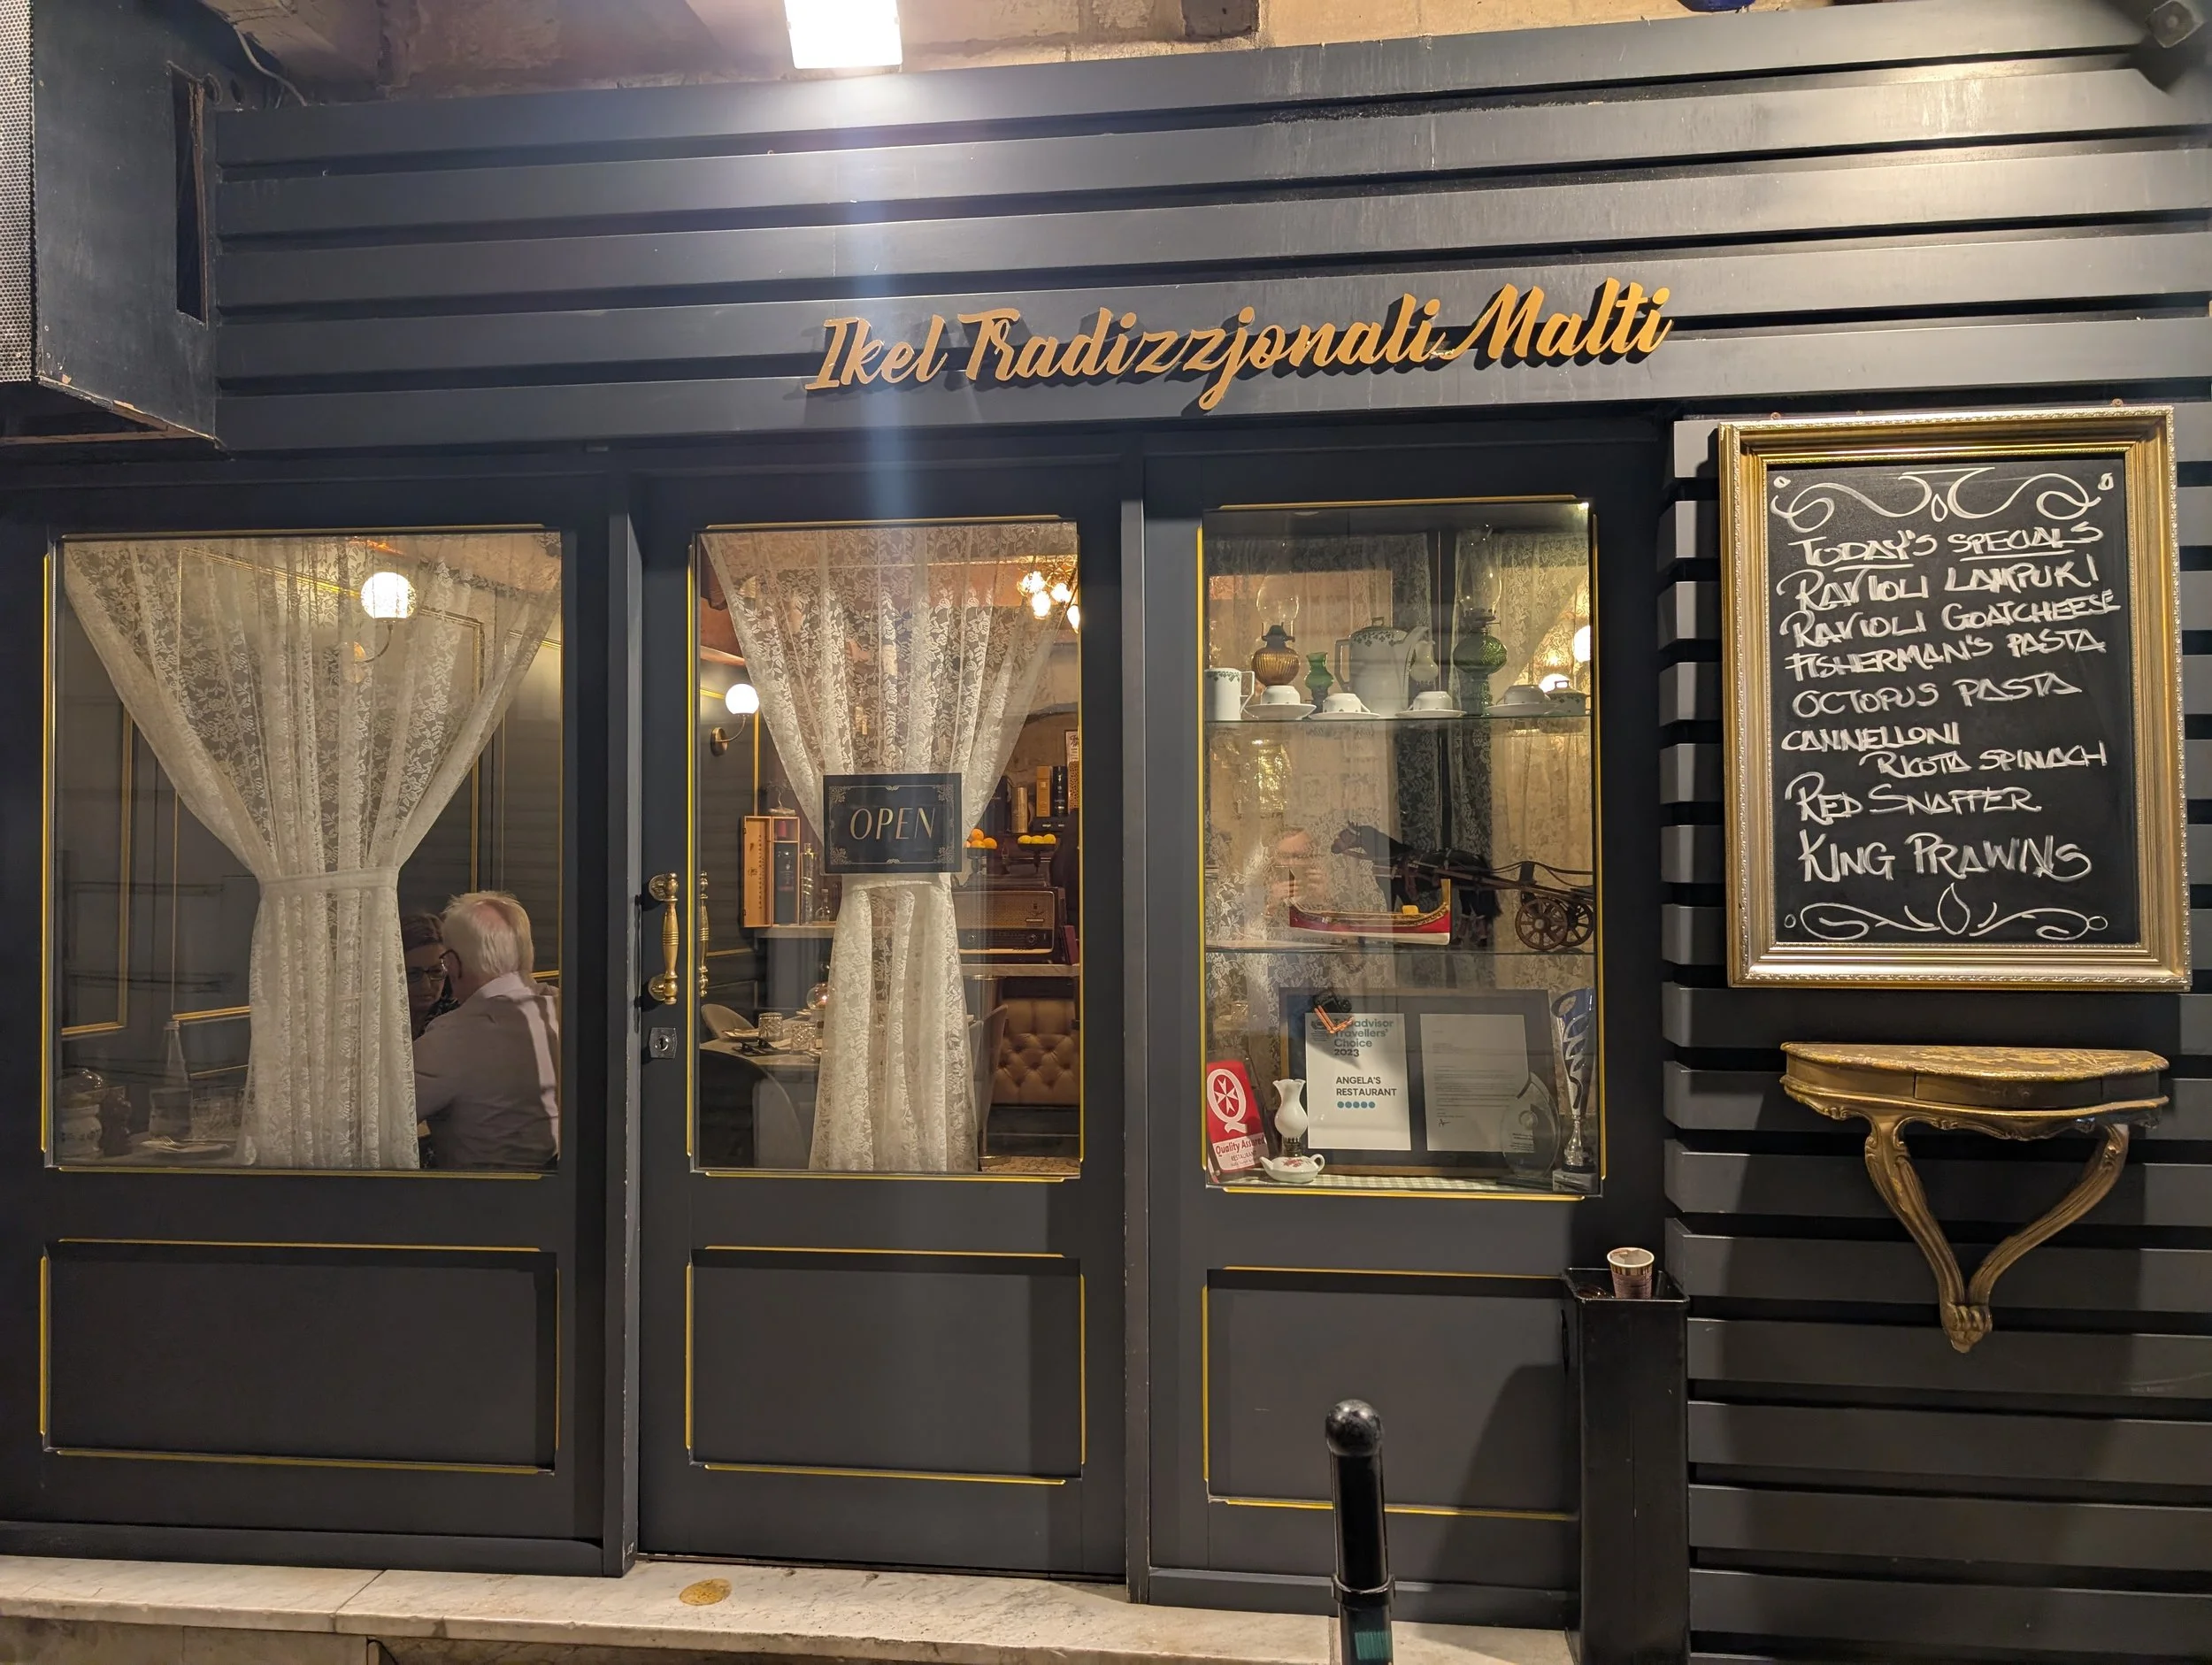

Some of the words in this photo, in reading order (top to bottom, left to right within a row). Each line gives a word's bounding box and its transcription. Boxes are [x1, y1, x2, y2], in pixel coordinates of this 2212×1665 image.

[804, 314, 949, 390] Ikel
[957, 293, 1446, 410] Tradizzjonali
[1441, 277, 1673, 360] Malti
[1788, 530, 1938, 567] TODAY'S
[1947, 521, 2104, 555] SPECIALS
[1776, 567, 1930, 612] RAVIOLI
[1944, 553, 2100, 594] LAMPUKI
[1779, 610, 1926, 648] RAVIOLI
[1941, 588, 2121, 633] GOATCHEESE
[1785, 633, 1994, 682] FISHERMAN'S
[2006, 627, 2108, 658] PASTA
[1792, 681, 1940, 719] OCTOPUS
[1952, 671, 2083, 708] PASTA
[1780, 721, 1962, 753] CANNELLONI
[1978, 739, 2108, 771] SPINACH
[1785, 771, 1863, 825] RED
[849, 806, 936, 840] OPEN
[1797, 828, 1897, 883] KING
[1903, 832, 2093, 883] PRAWNS
[1333, 1037, 1373, 1048] Choice
[1333, 1047, 1361, 1058] 2023
[1335, 1075, 1382, 1086] ANGELA'S
[1335, 1087, 1398, 1097] RESTAURANT
[1215, 1141, 1240, 1157] Quality
[1240, 1133, 1266, 1150] Assured
